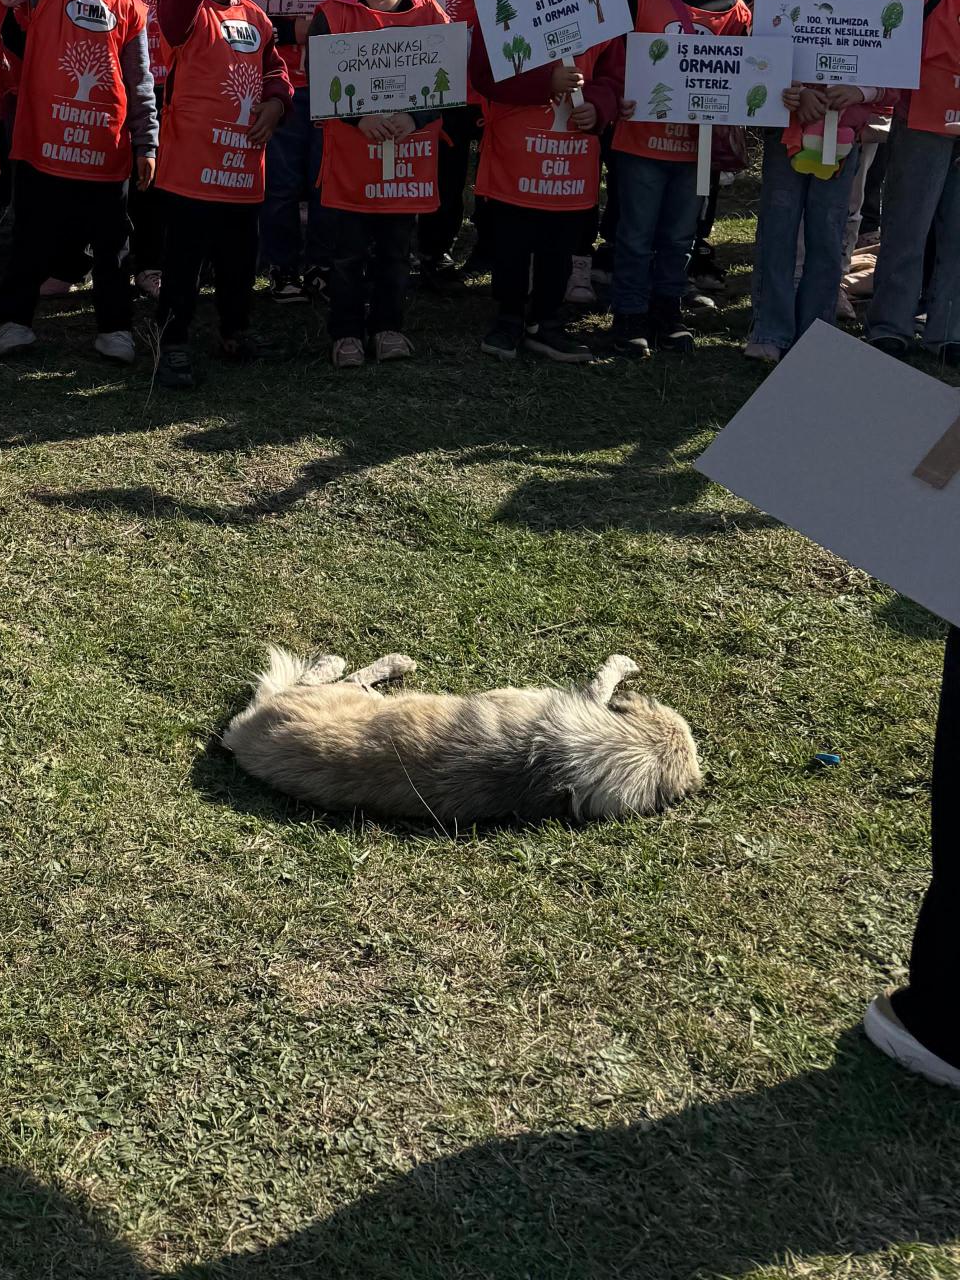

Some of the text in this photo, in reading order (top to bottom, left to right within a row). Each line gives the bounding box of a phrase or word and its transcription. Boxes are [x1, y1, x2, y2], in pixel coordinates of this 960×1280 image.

[76, 2, 106, 19] TEMA
[535, 0, 544, 11] 81
[533, 2, 580, 27] 81 ORMAN
[807, 15, 869, 26] 100. YILIMIZDA
[227, 24, 252, 41] TEMA
[794, 25, 880, 37] GELECEK NESİLLERE
[372, 40, 422, 56] BANKASI
[678, 42, 743, 57] İŞ BANKASI
[836, 38, 850, 46] BİR
[853, 38, 882, 48] DÜNYA
[338, 58, 391, 73] ORMANI
[679, 59, 741, 74] ORMANI
[685, 76, 732, 90] İSTERİZ.
[51, 100, 110, 128] TÜRKİYE
[63, 124, 90, 146] ÇÖL
[525, 133, 588, 155] TÜRKİYE
[42, 144, 106, 166] OLMASIN
[222, 149, 246, 169] ÇÖL
[541, 157, 570, 178] ÇÖL
[200, 168, 255, 189] OLMASIN
[518, 176, 584, 196] OLMASIN
[365, 180, 434, 198] OLMASIN
